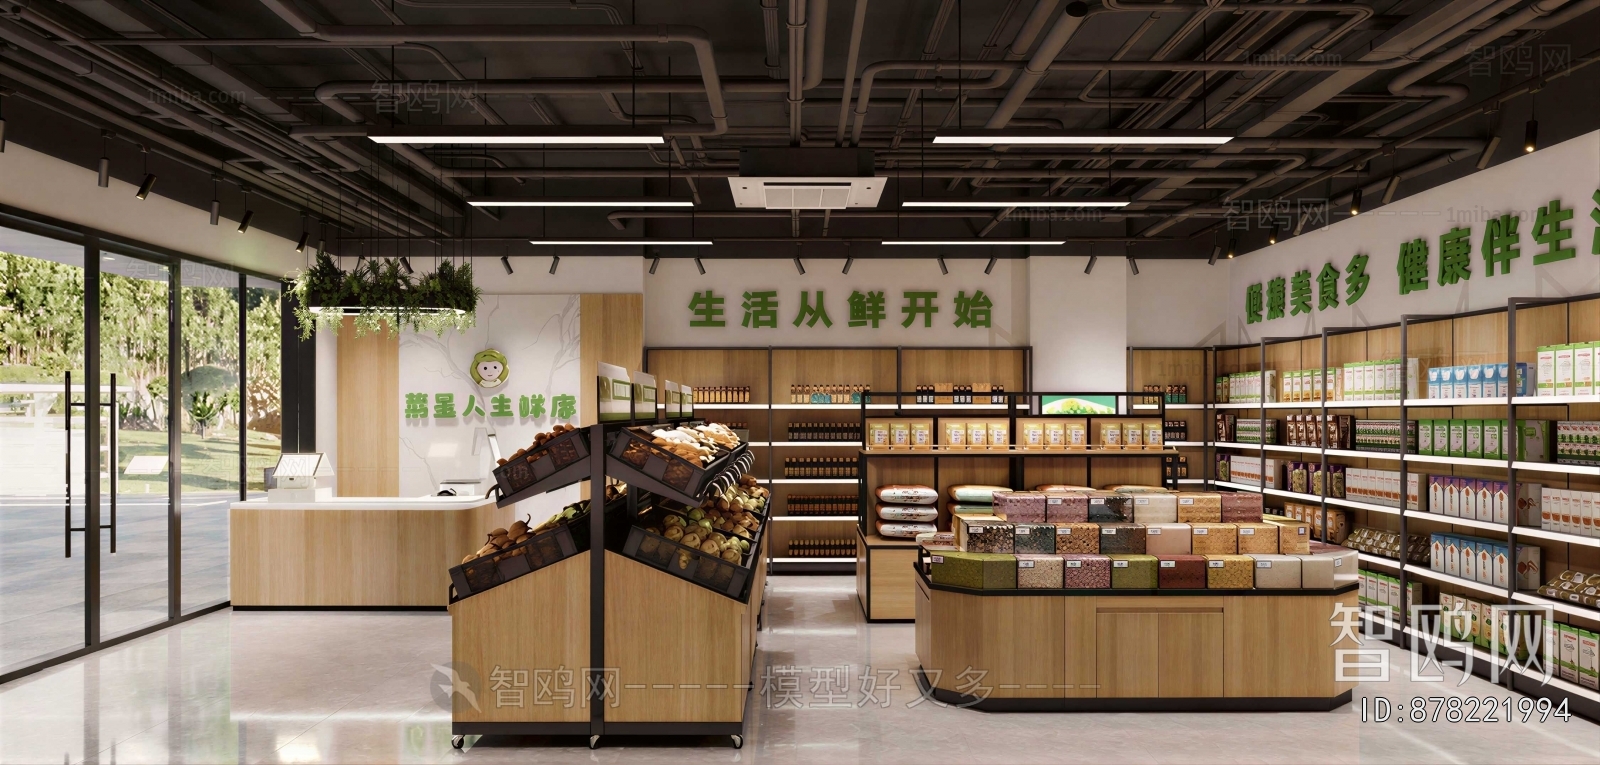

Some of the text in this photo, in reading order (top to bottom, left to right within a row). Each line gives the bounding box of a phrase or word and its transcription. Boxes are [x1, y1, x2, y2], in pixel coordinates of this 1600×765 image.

[687, 289, 994, 330] 生活从鲜开始
